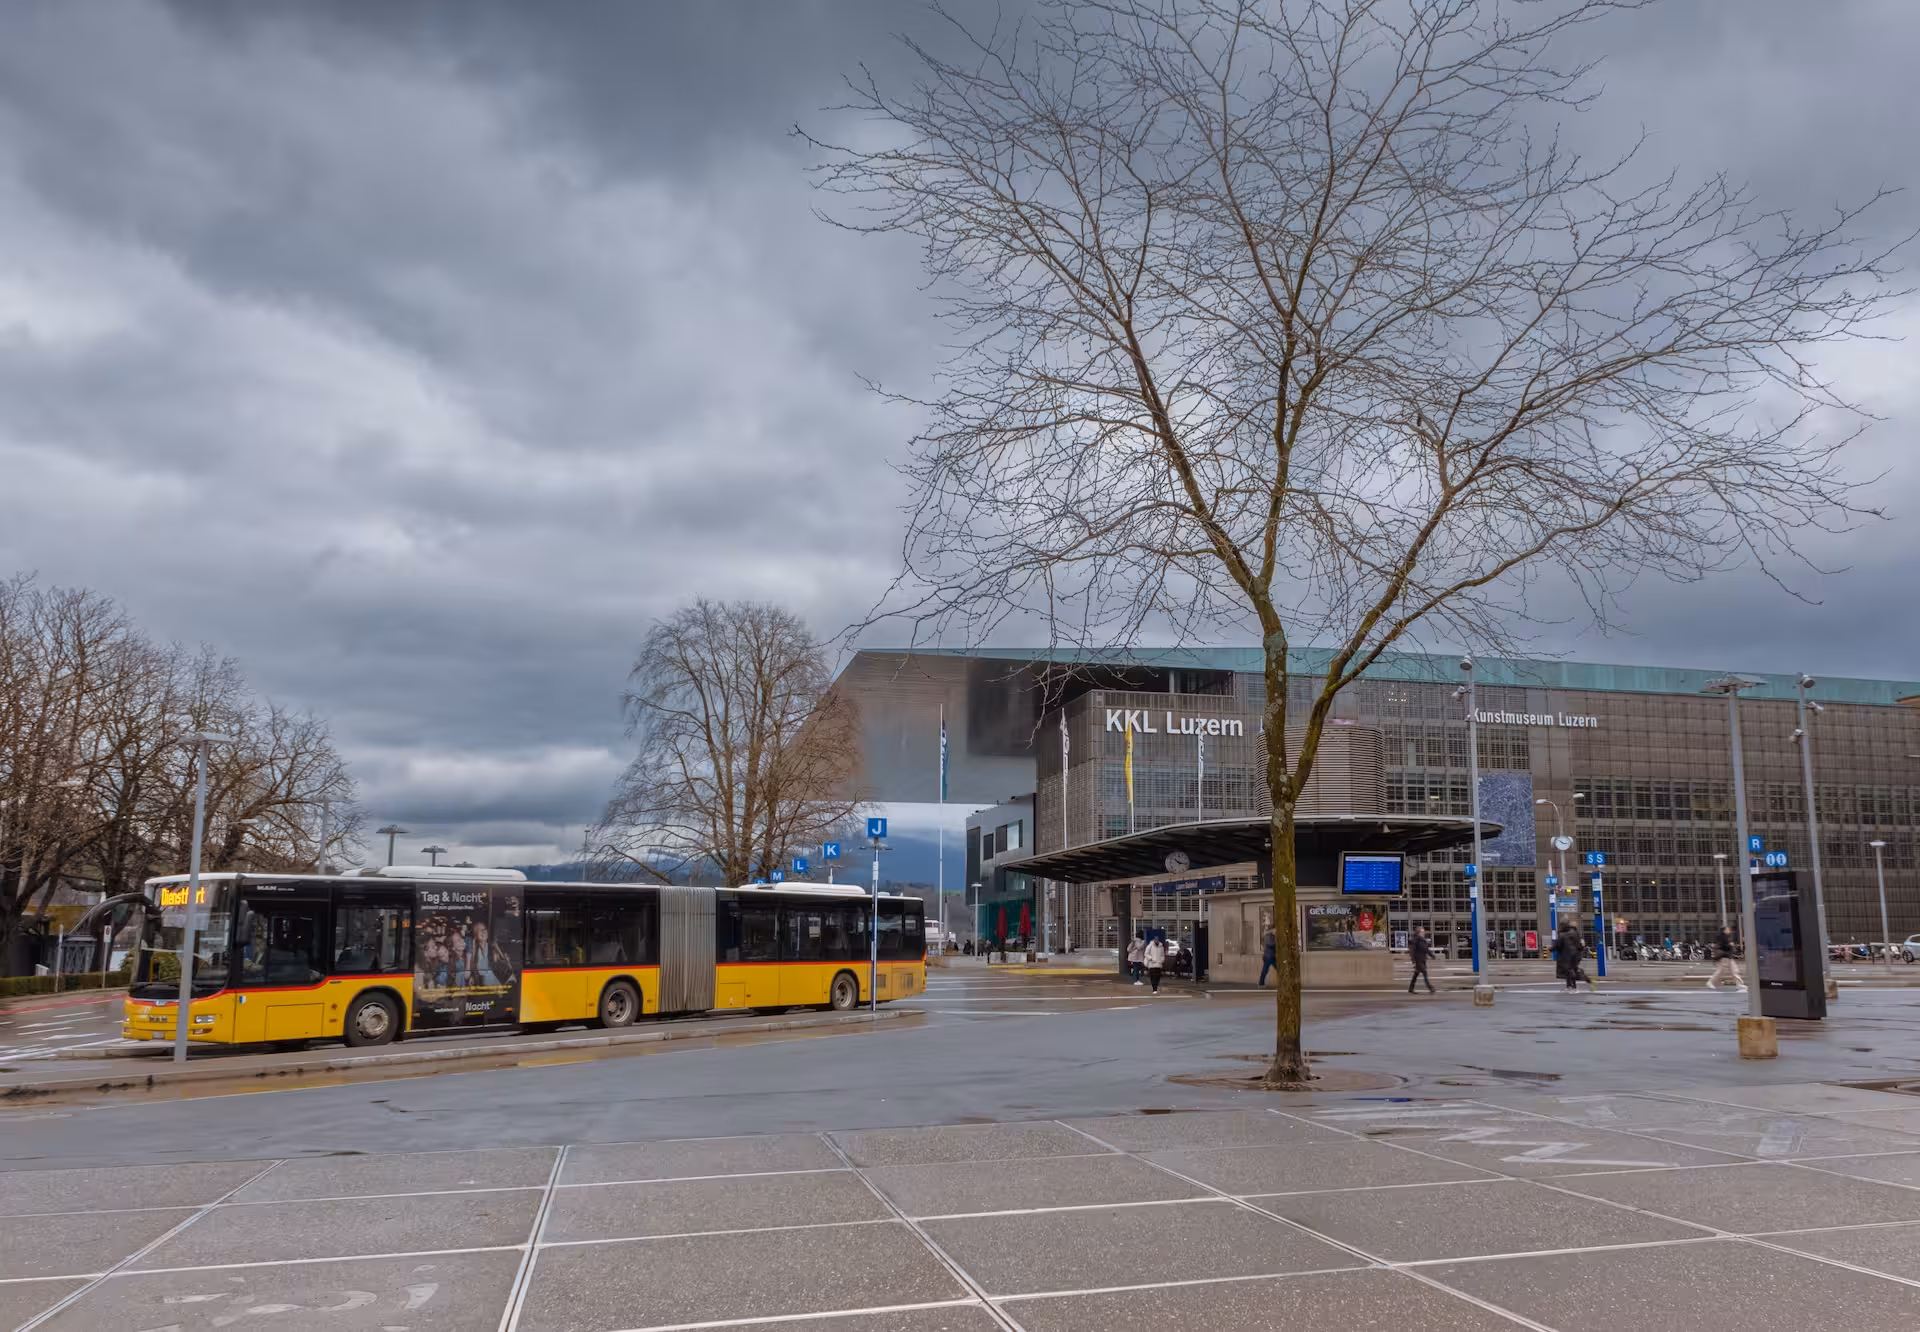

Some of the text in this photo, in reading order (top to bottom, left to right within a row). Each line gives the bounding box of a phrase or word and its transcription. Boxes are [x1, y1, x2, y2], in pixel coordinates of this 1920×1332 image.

[1106, 709, 1243, 737] KKL Luzern
[1474, 708, 1598, 728] Kunstmuseum Luzern
[872, 820, 882, 834] J
[1752, 839, 1760, 849] R
[826, 845, 837, 856] K
[1596, 854, 1603, 863] S
[796, 861, 804, 870] L
[772, 872, 782, 881] M
[161, 887, 205, 905] Dienstfrt
[420, 891, 483, 904] Tag & Nacht
[1309, 907, 1326, 915] GET
[465, 1001, 491, 1011] Nacht
